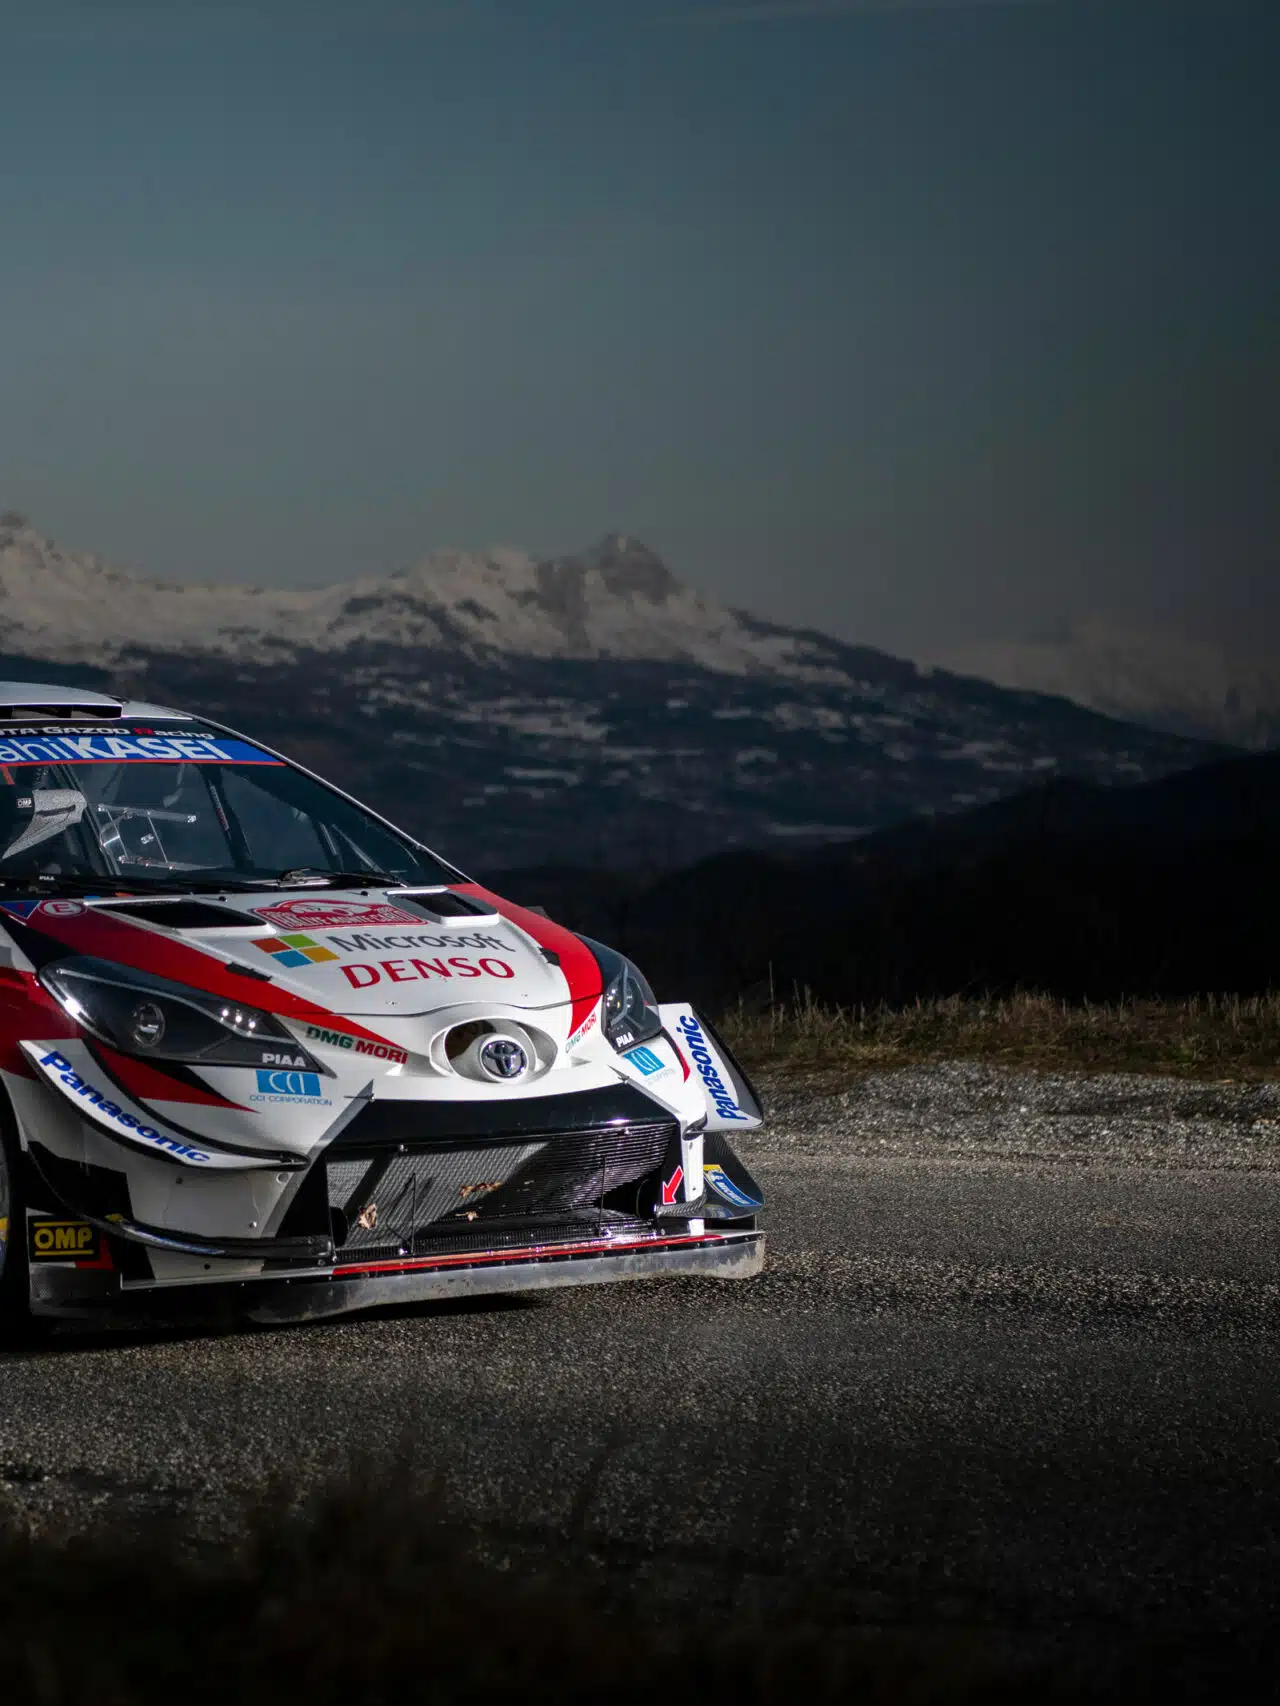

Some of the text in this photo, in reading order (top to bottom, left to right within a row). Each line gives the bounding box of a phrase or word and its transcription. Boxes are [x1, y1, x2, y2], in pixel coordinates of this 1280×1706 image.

[42, 726, 131, 736] GAZOO
[133, 727, 216, 740] Racing
[326, 933, 516, 952] Microsoft
[340, 957, 515, 989] DENSO
[306, 1026, 409, 1065] DMG MORI
[616, 1031, 635, 1048] PIAA
[262, 1053, 307, 1068] PIAA
[676, 1015, 748, 1120] Panasonic
[39, 1051, 211, 1163] Panasonic
[34, 1227, 93, 1249] OMP
